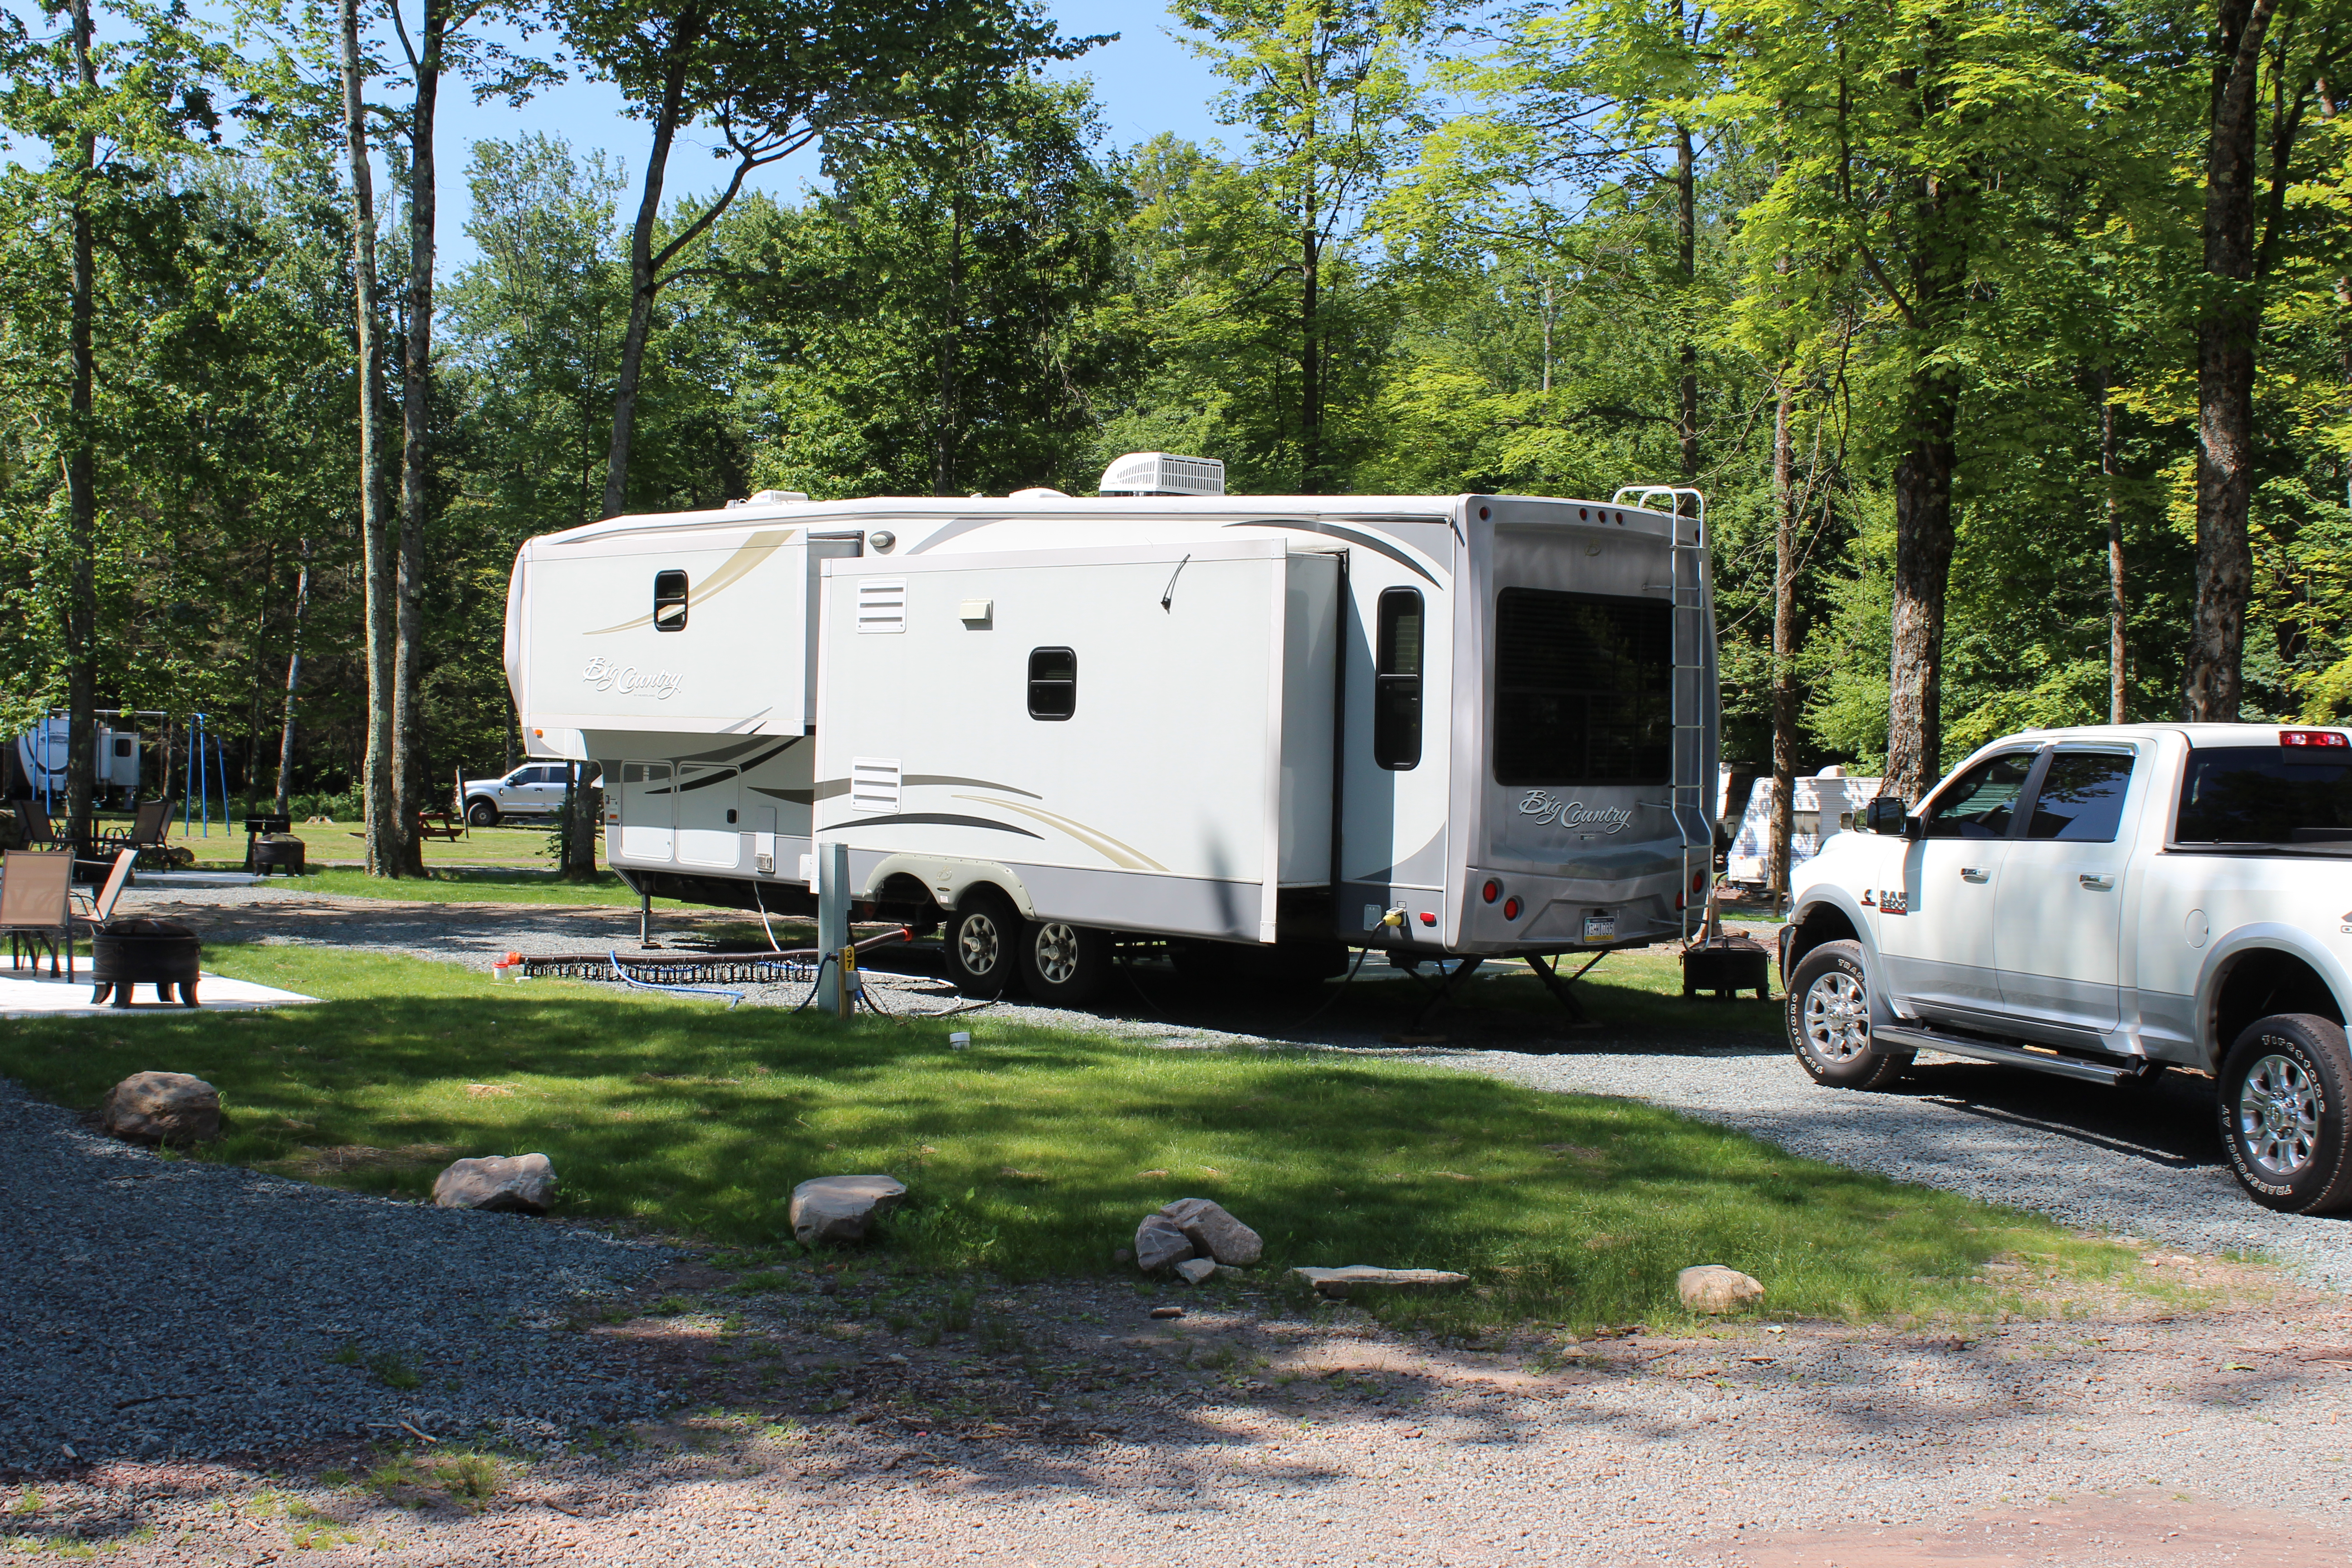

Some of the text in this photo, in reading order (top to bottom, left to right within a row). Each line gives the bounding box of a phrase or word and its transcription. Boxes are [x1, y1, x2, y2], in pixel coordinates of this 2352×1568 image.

[583, 656, 684, 700] Big Country
[1519, 789, 1632, 834] Big Country
[1880, 890, 1909, 900] RAM
[2222, 1105, 2293, 1196] TRANSFORCE AT
